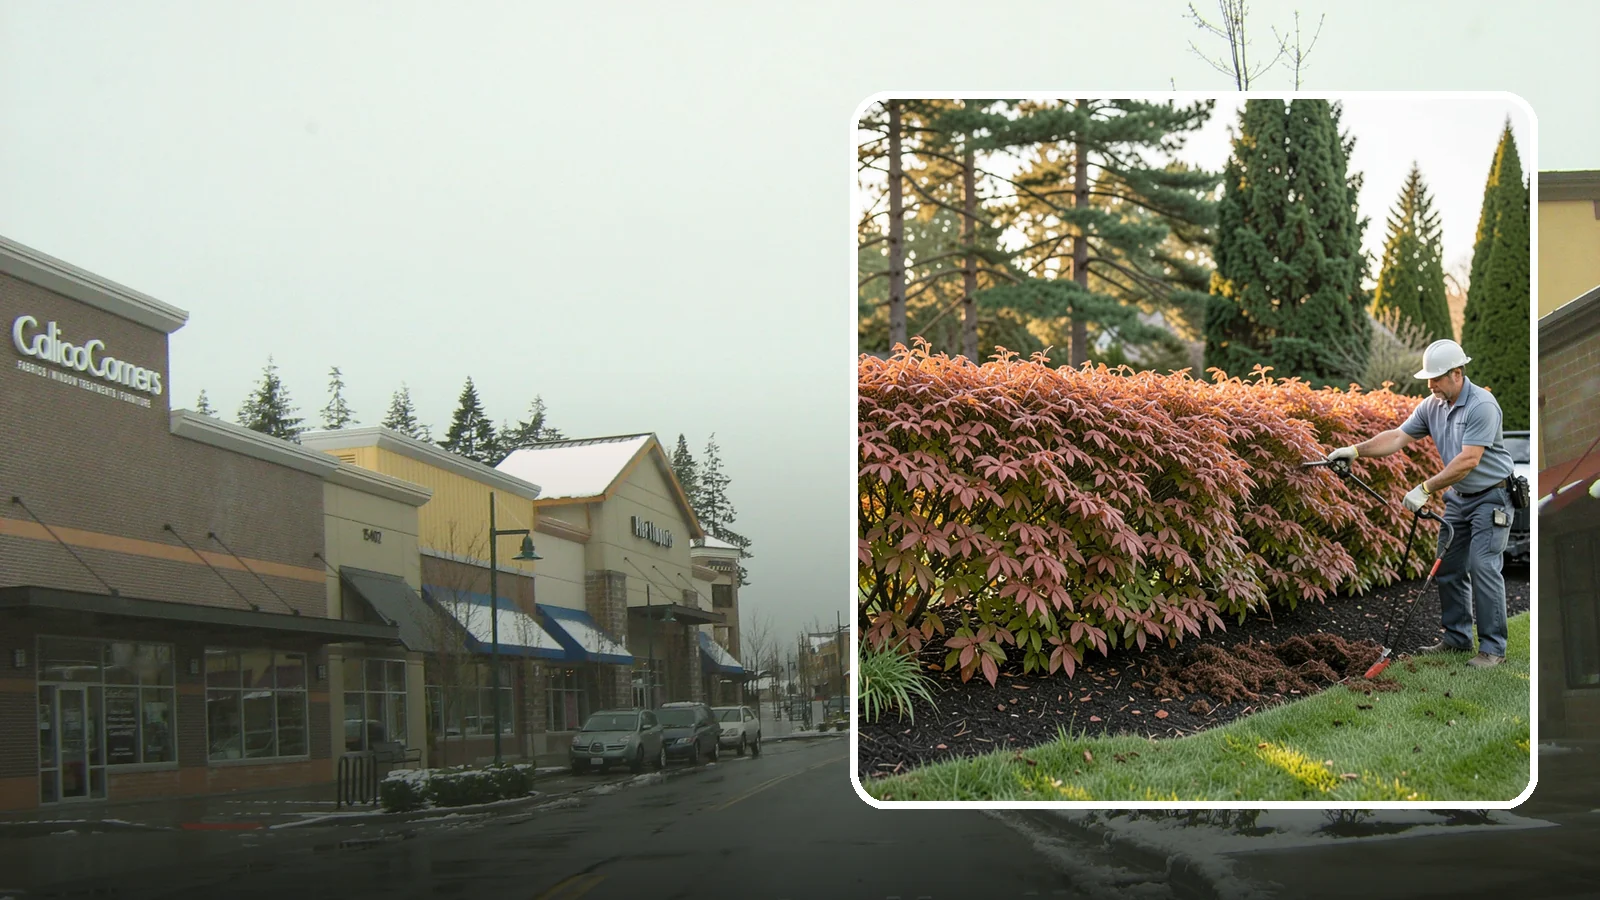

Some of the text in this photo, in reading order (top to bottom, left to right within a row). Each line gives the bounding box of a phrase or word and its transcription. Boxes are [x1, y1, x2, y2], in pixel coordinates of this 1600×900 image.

[17, 360, 47, 377] FABRICS
[52, 371, 78, 386] WINDOW
[79, 378, 116, 398] TREATMENTS
[120, 391, 151, 408] FURNITURE
